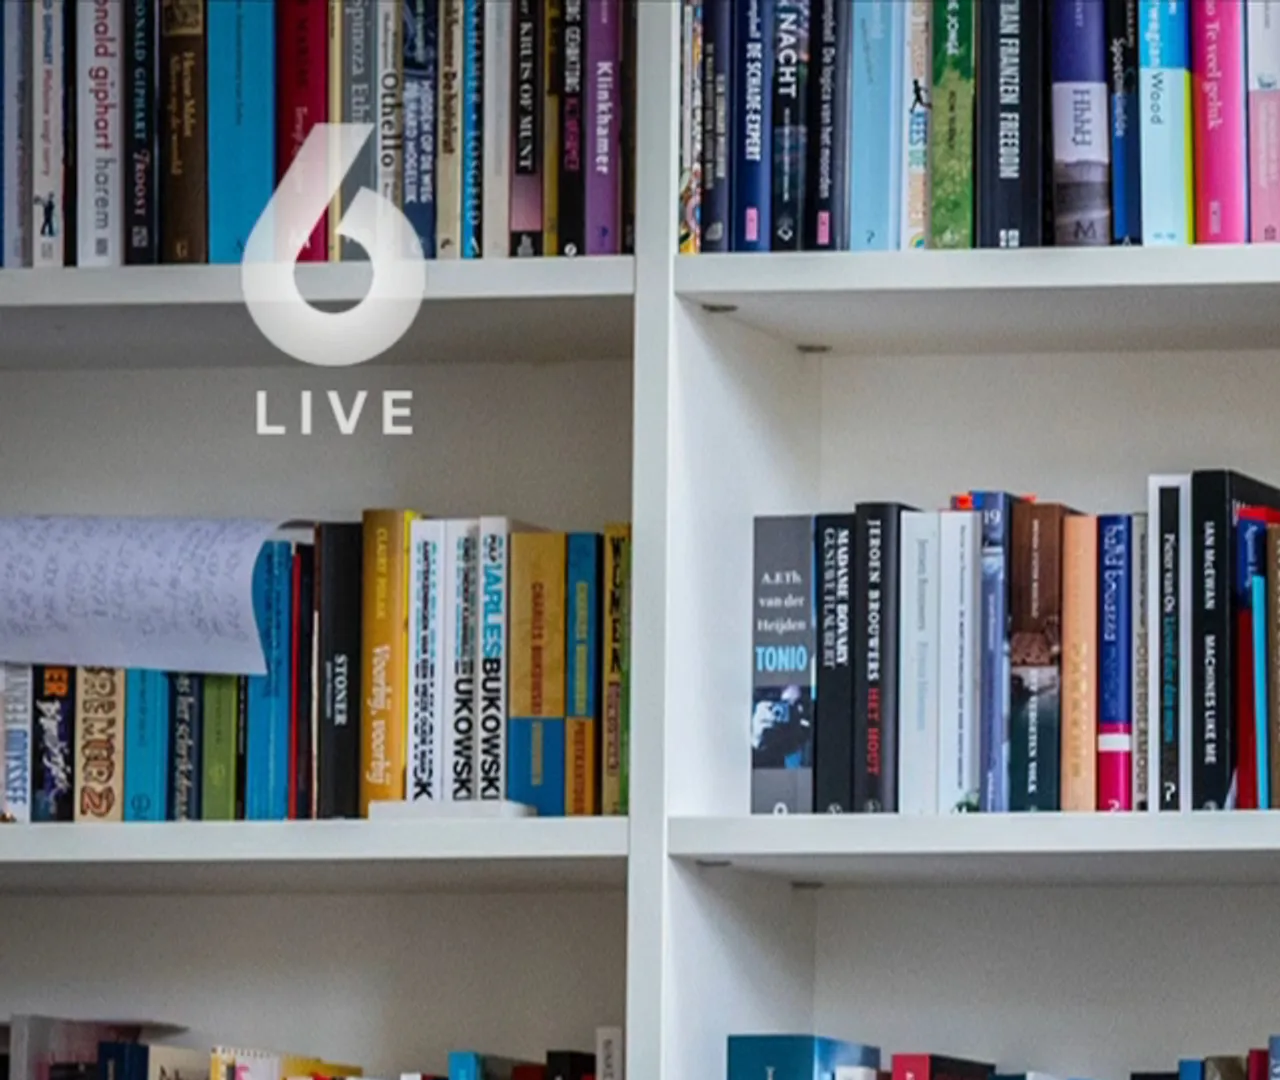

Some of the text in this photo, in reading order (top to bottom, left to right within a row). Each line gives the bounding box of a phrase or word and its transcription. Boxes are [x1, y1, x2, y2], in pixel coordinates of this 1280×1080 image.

[778, 13, 797, 97] NACHT
[1150, 72, 1164, 125] Wood
[1203, 21, 1223, 130] Te veel geluk
[90, 67, 116, 149] giphart
[381, 72, 402, 168] Othello
[595, 61, 612, 174] Klinkhamer
[746, 43, 761, 161] DE SCHADE-EXPERT
[1000, 39, 1019, 178] FRANZEN FREEDOM
[95, 157, 115, 229] harem
[836, 528, 848, 665] MADAME BOVARY
[1163, 533, 1177, 612] Pieter van Os
[755, 646, 807, 672] TONIO
[867, 519, 881, 775] JEROEN BROUWERS HET HOUT
[1204, 521, 1216, 764] IAN McEWAN MACHINES LIKE ME
[334, 654, 347, 725] STONER
[80, 787, 115, 817] 2
